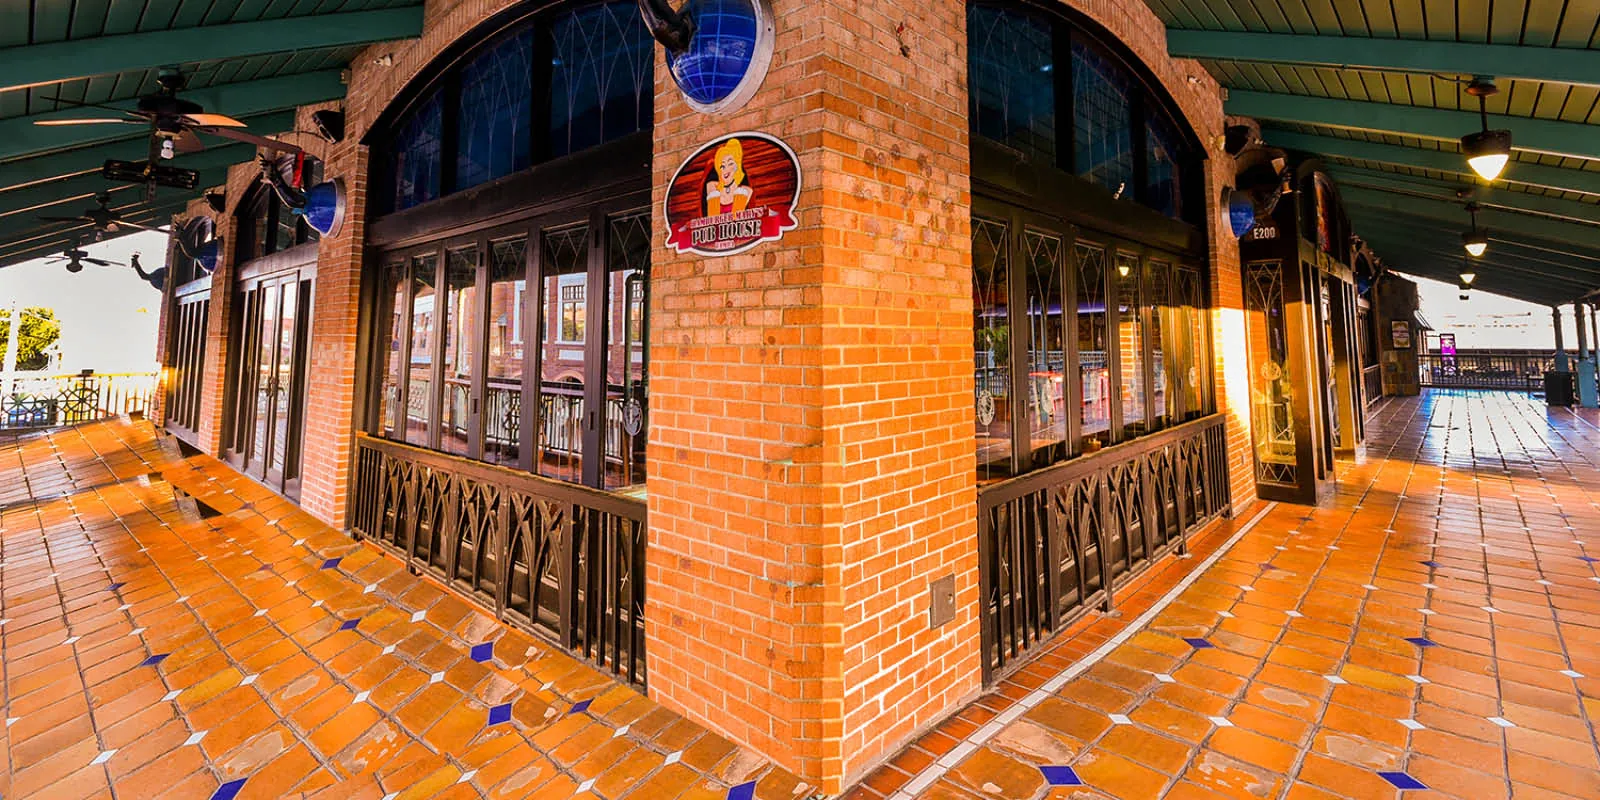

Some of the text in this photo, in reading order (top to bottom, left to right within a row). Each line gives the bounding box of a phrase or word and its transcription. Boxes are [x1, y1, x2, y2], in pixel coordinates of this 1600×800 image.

[692, 220, 762, 245] PUB HOUSE
[1253, 227, 1276, 239] E200
